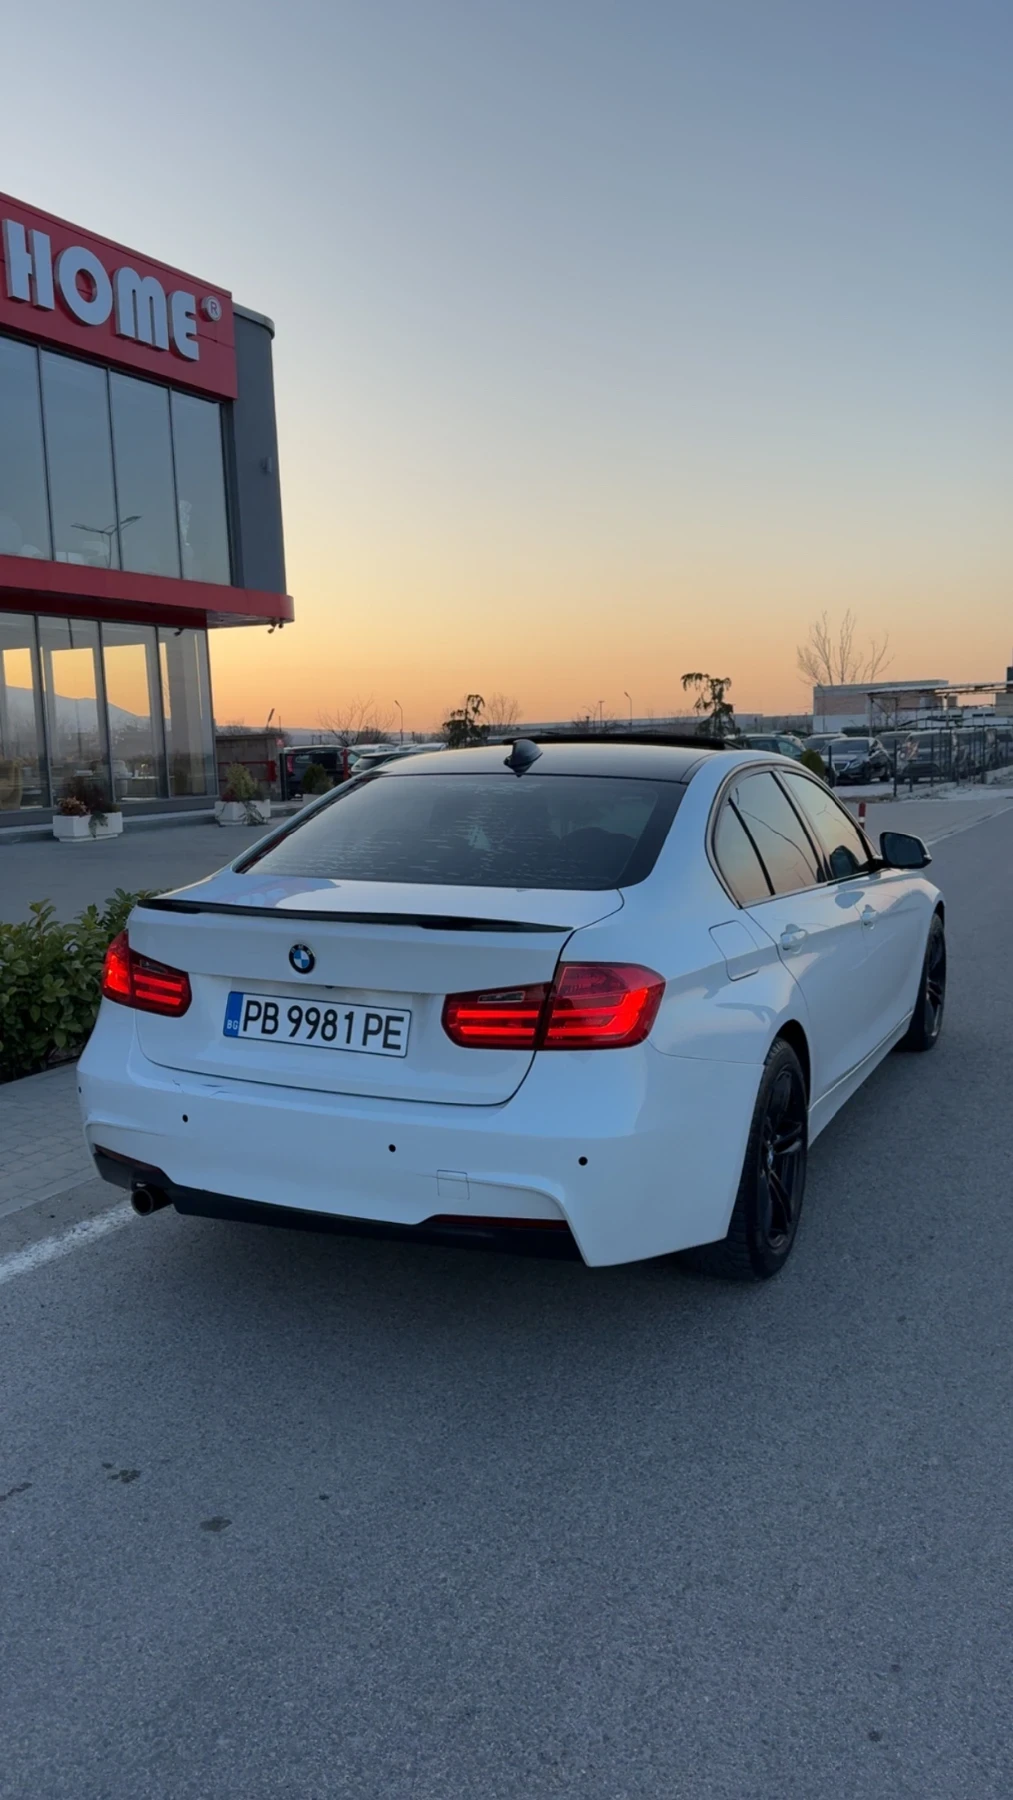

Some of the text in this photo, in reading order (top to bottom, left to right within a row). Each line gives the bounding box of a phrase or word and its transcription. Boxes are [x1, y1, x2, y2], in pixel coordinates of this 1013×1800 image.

[3, 218, 200, 362] HOME
[226, 1019, 238, 1030] BG
[243, 1000, 404, 1050] PB 9981 PE
